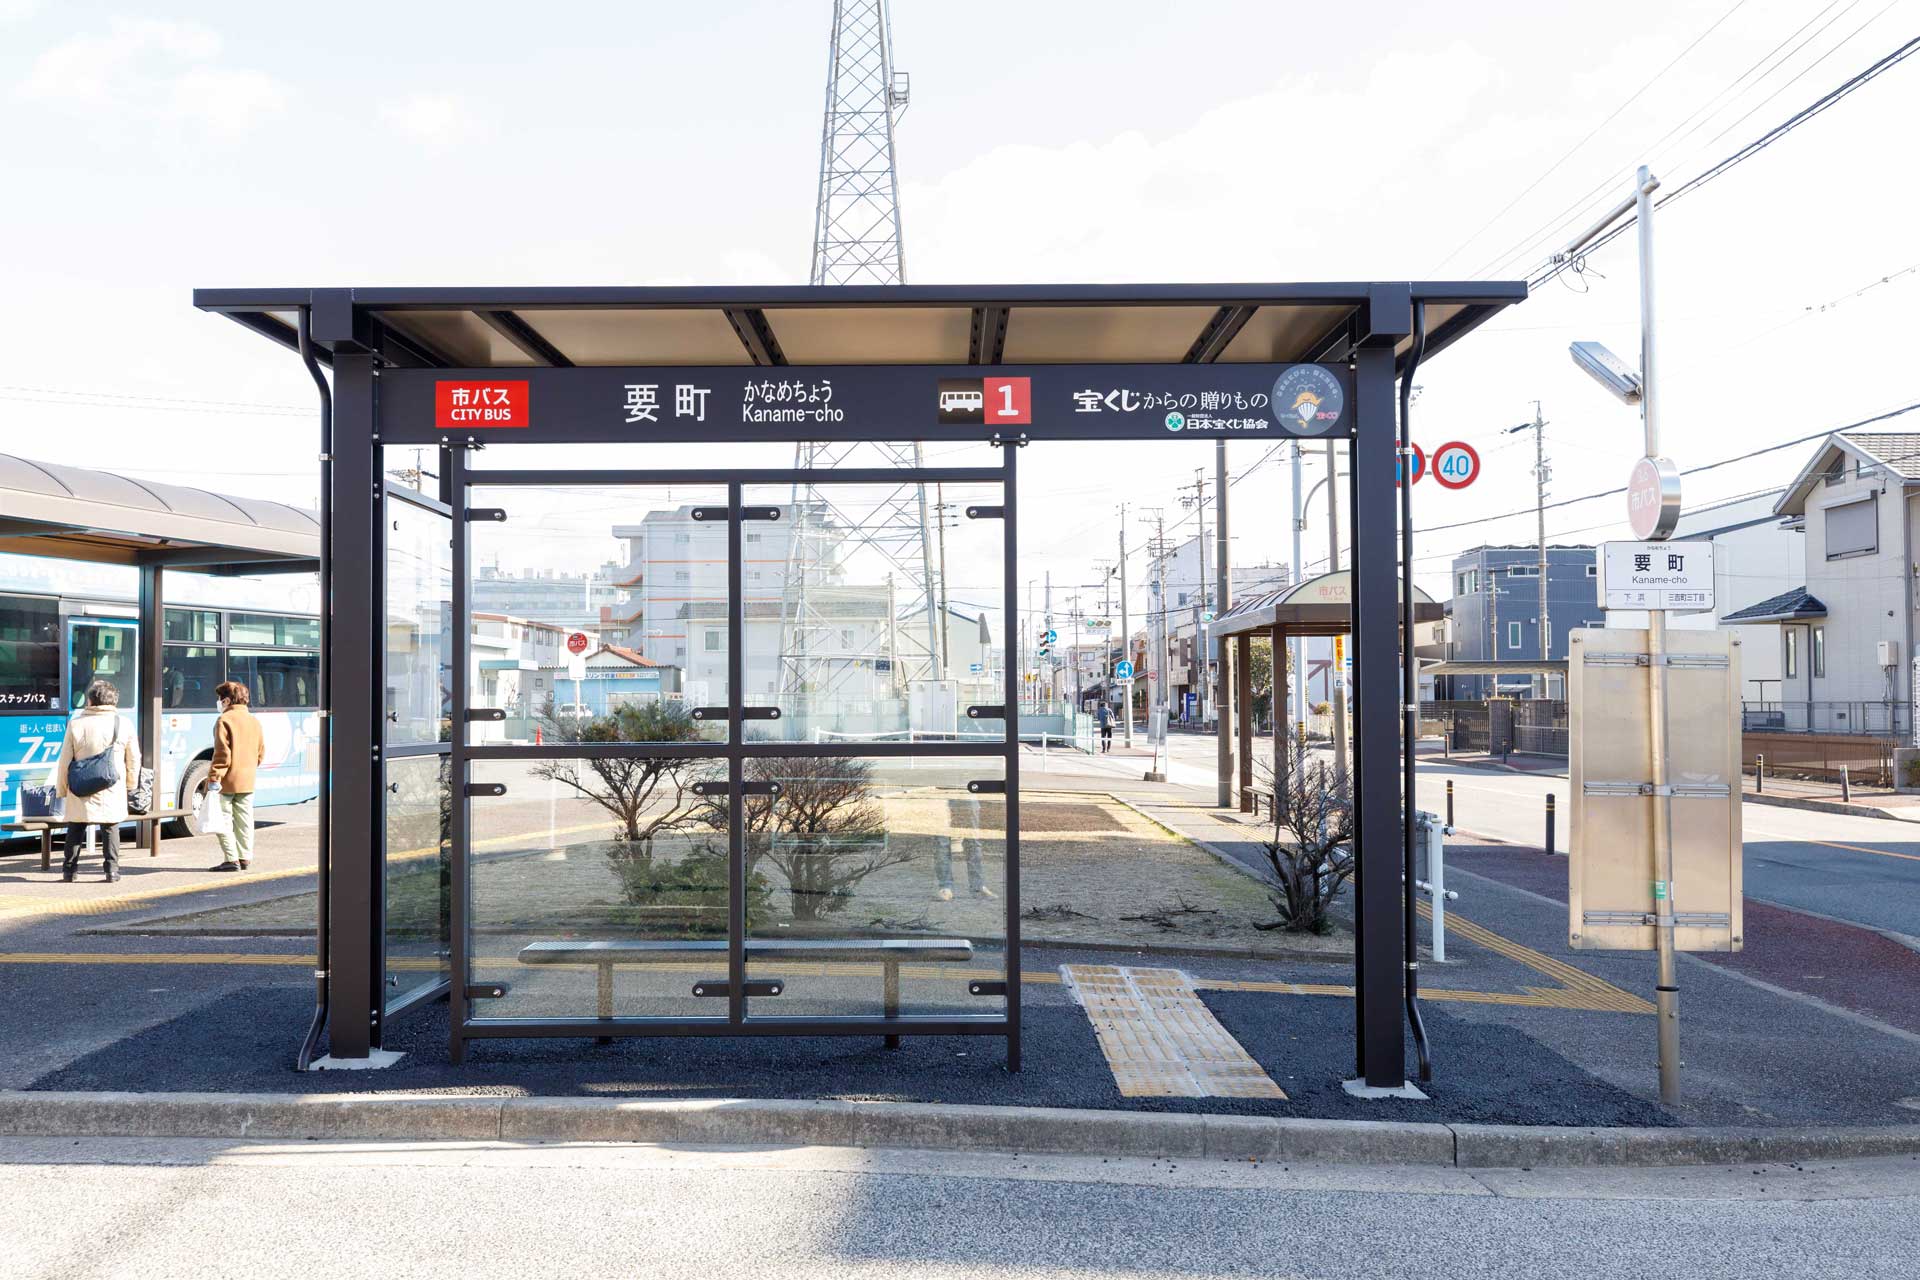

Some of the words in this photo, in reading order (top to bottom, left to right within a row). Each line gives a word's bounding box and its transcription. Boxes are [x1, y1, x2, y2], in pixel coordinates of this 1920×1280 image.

[451, 387, 511, 407] 市バス
[744, 379, 833, 403] かなめちょう
[997, 384, 1019, 416] 1
[623, 384, 711, 423] 要町
[742, 403, 844, 423] Kaname-cho
[451, 408, 482, 421] CITY
[484, 408, 512, 421] BUS
[1186, 418, 1269, 430] 日本宝くじ協会
[1442, 455, 1469, 476] 40
[1632, 575, 1688, 584] Kaname-cho
